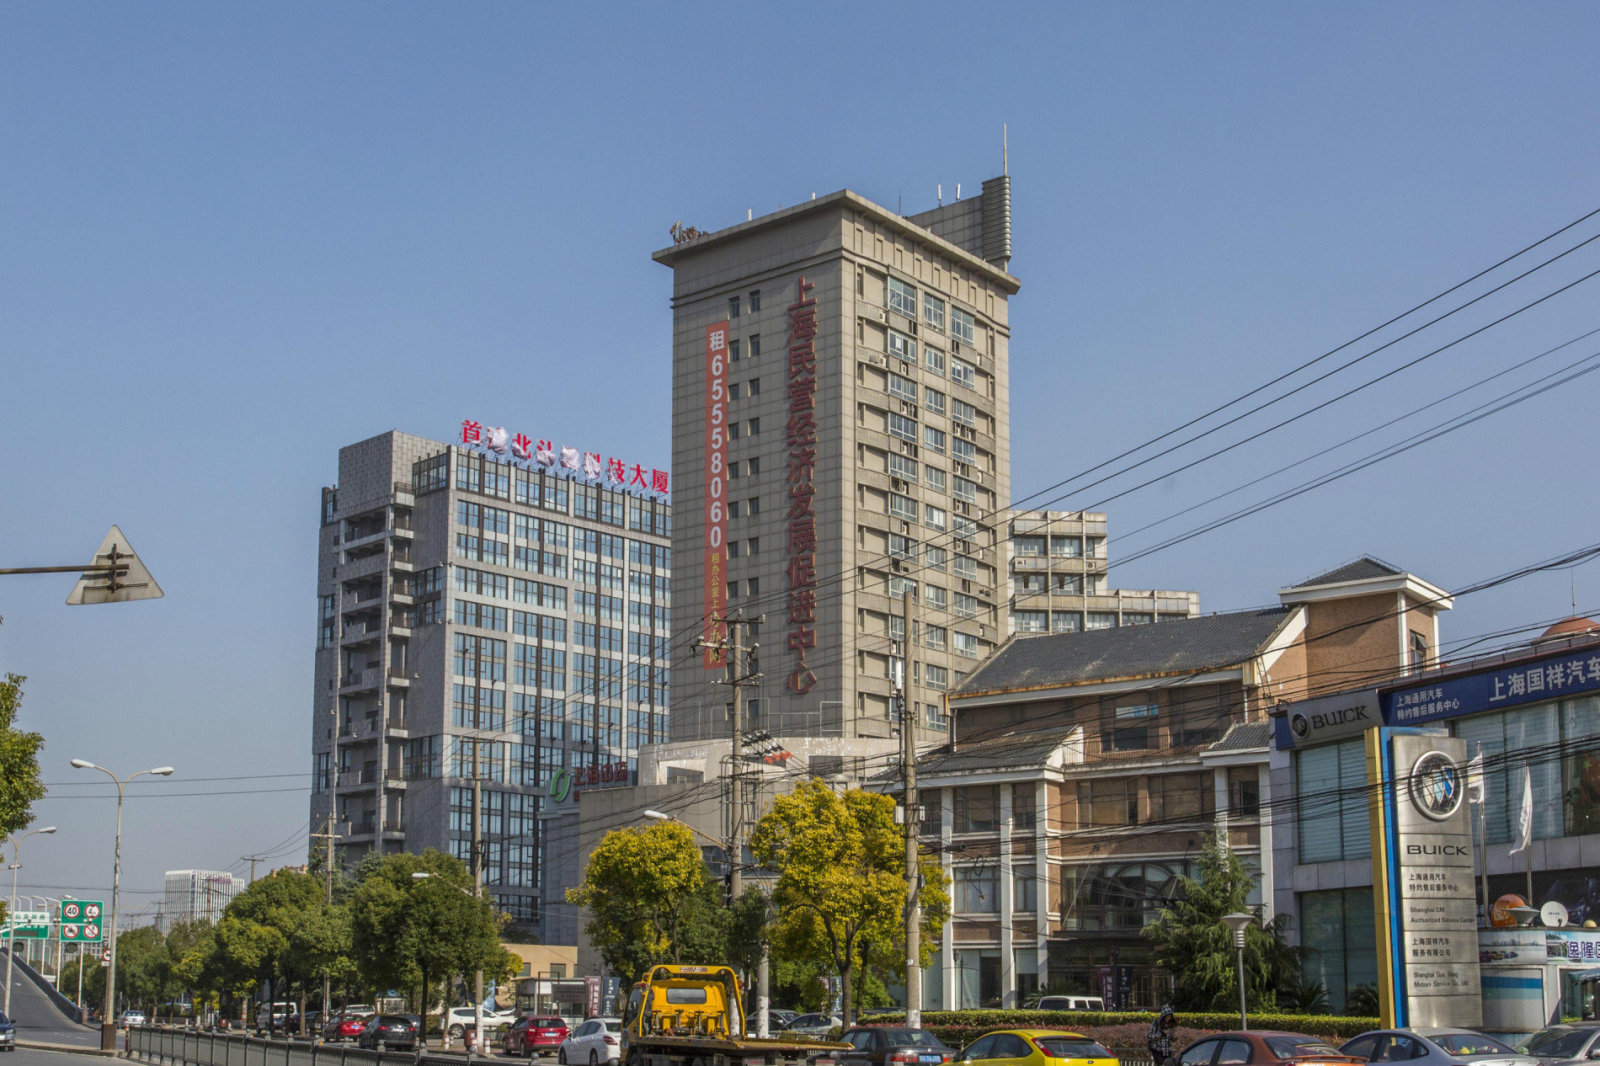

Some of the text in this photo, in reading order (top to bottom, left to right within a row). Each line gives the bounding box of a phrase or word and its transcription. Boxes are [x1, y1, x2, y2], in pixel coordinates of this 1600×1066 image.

[786, 276, 818, 694] 上海民营经济发展促进中心
[1396, 688, 1443, 707] 上海通用汽车
[1311, 705, 1370, 729] BUICK
[1397, 698, 1460, 720] 特约售后服务中心
[1407, 844, 1469, 856] BUICK
[67, 907, 77, 915] 40
[1413, 971, 1434, 979] Shanghai
